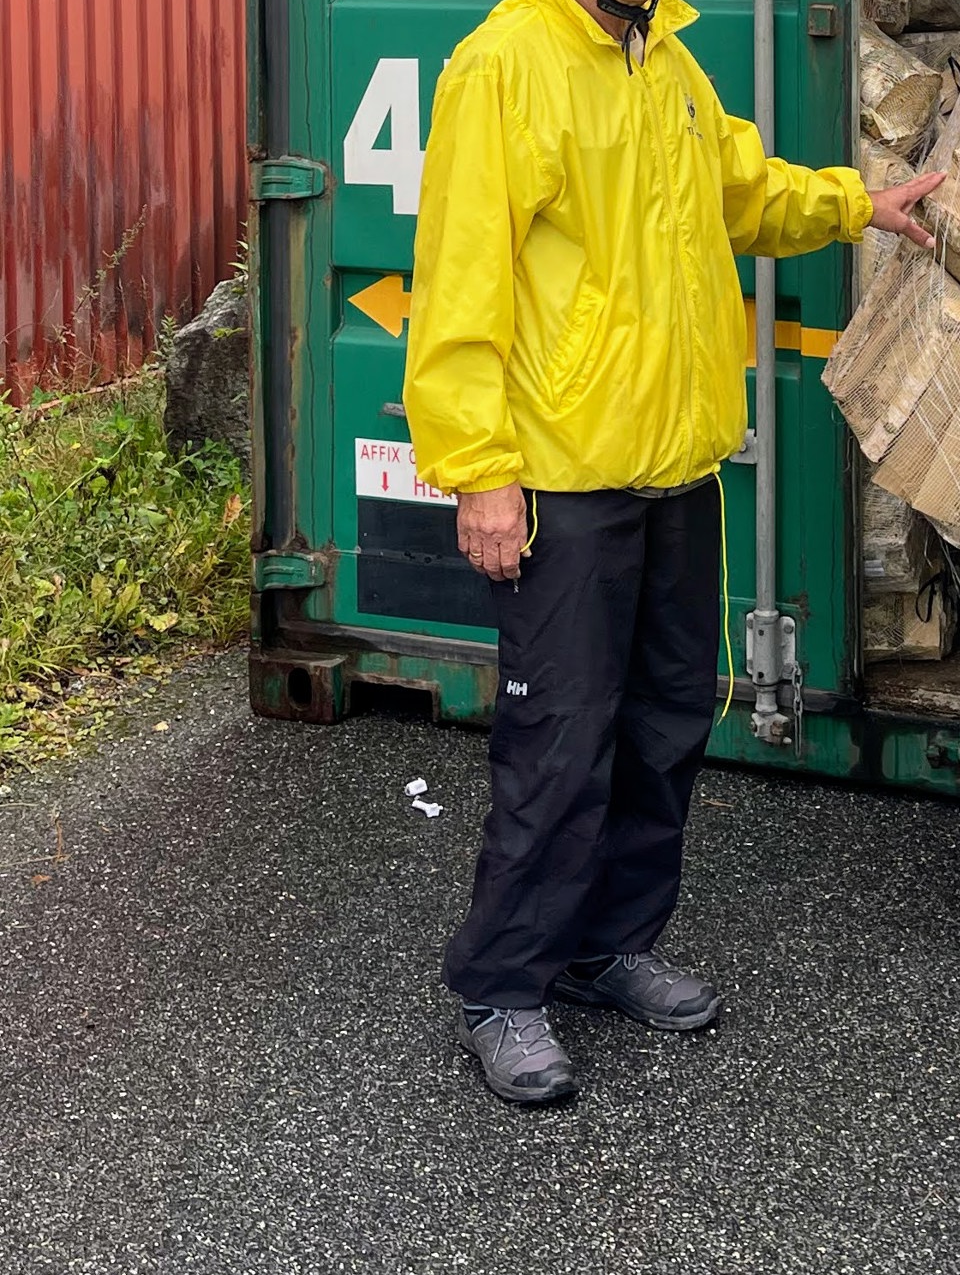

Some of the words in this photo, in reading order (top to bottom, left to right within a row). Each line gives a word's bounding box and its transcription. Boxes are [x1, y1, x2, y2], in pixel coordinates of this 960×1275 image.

[343, 58, 452, 215] 4
[360, 444, 400, 463] AFFIX
[506, 680, 528, 696] HH
